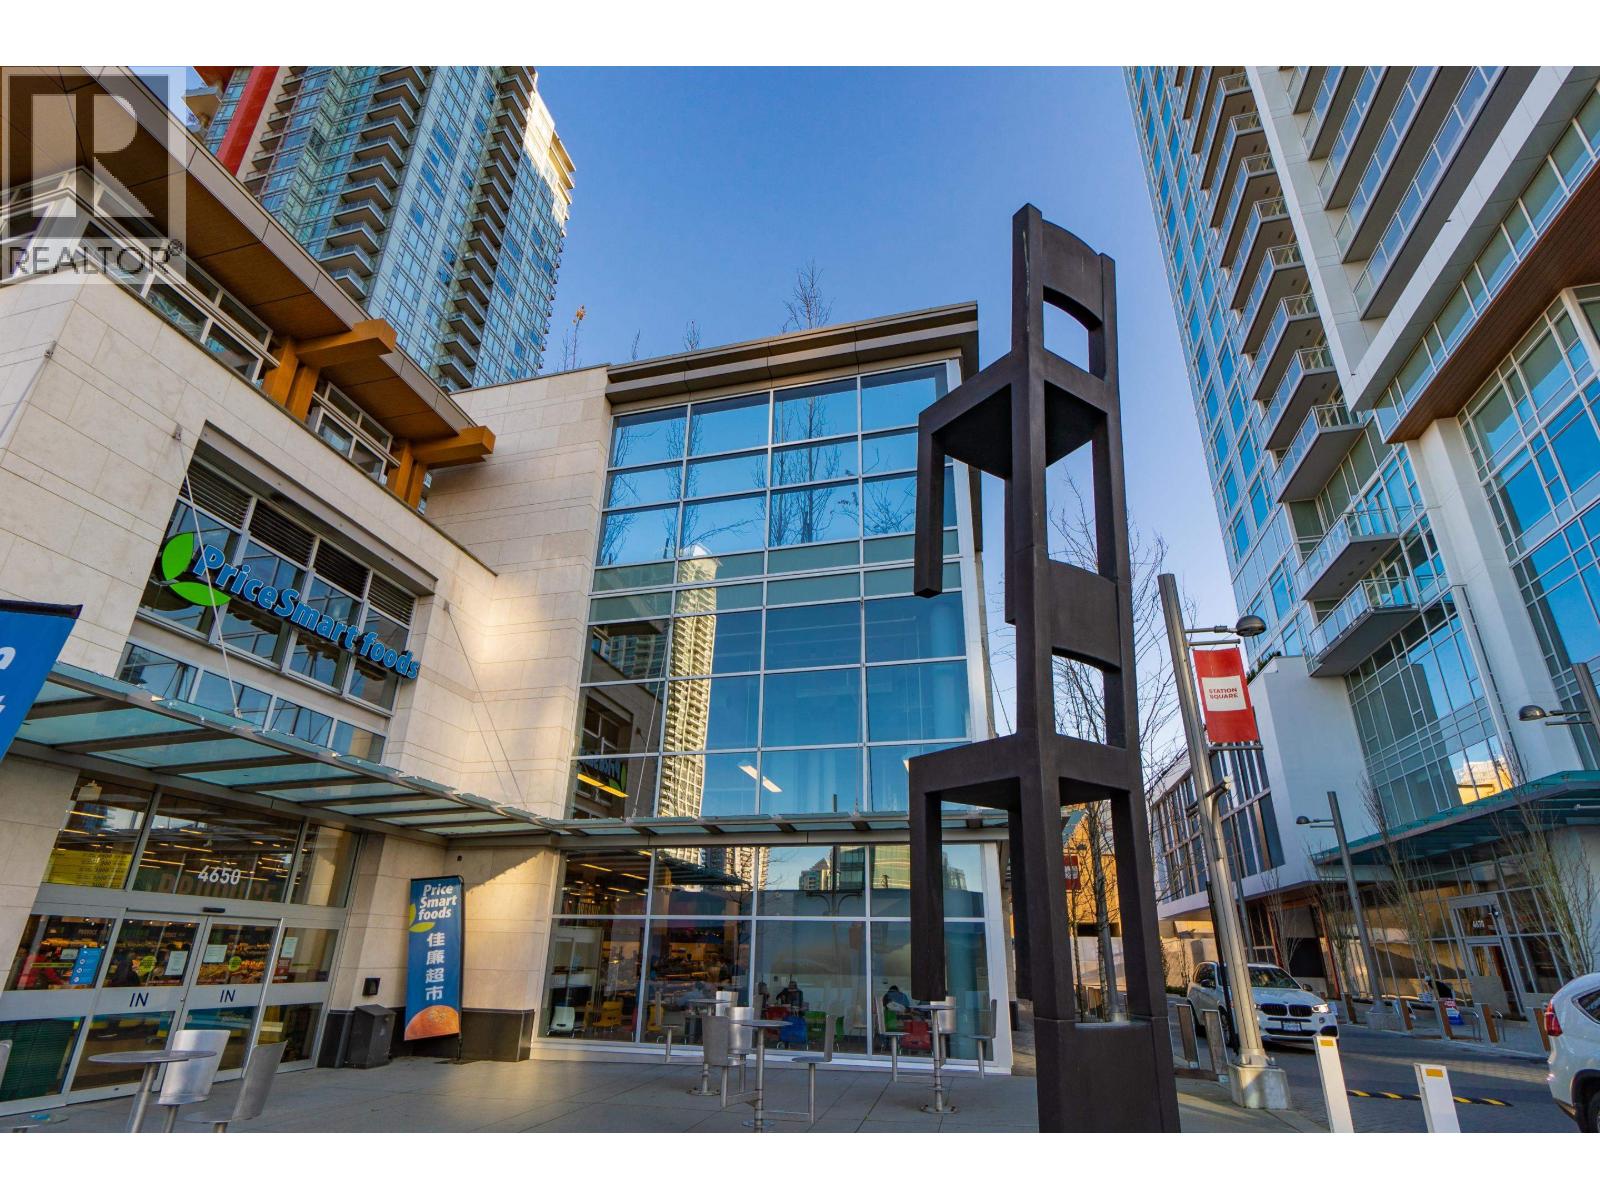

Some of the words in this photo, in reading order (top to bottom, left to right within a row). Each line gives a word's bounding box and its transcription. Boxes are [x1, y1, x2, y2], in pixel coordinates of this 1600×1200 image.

[192, 543, 361, 650] PriceSmart
[357, 630, 421, 680] foods
[197, 864, 242, 886] 4650
[422, 884, 454, 897] Price
[419, 895, 458, 909] Smart
[418, 906, 452, 921] foods
[425, 932, 446, 1001] 佳廉超市
[129, 992, 150, 1008] IN
[219, 989, 236, 1003] IN
